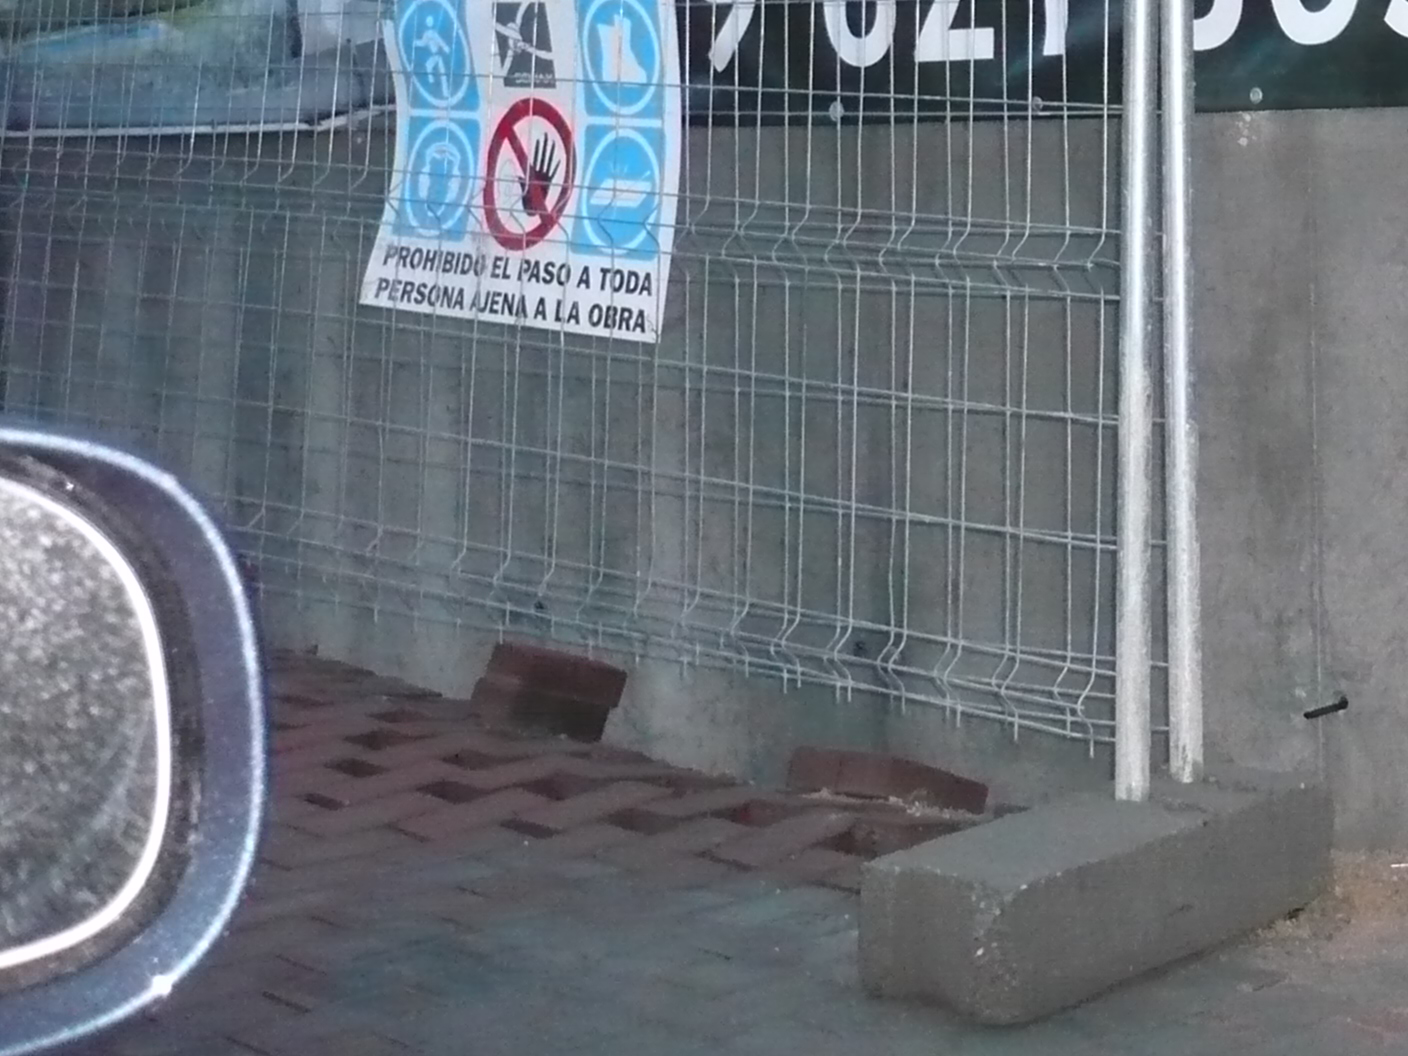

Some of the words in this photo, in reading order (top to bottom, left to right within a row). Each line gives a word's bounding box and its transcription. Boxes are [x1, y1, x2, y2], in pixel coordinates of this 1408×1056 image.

[383, 245, 486, 278] PROHIBIDO
[490, 255, 512, 280] EL
[518, 259, 572, 286] PASO
[576, 265, 591, 290] A
[599, 267, 653, 297] TODA
[374, 278, 465, 310] PERSONA
[469, 288, 529, 319] AJENA
[533, 296, 548, 322] A
[554, 298, 581, 326] LA
[588, 303, 648, 334] OBRA
